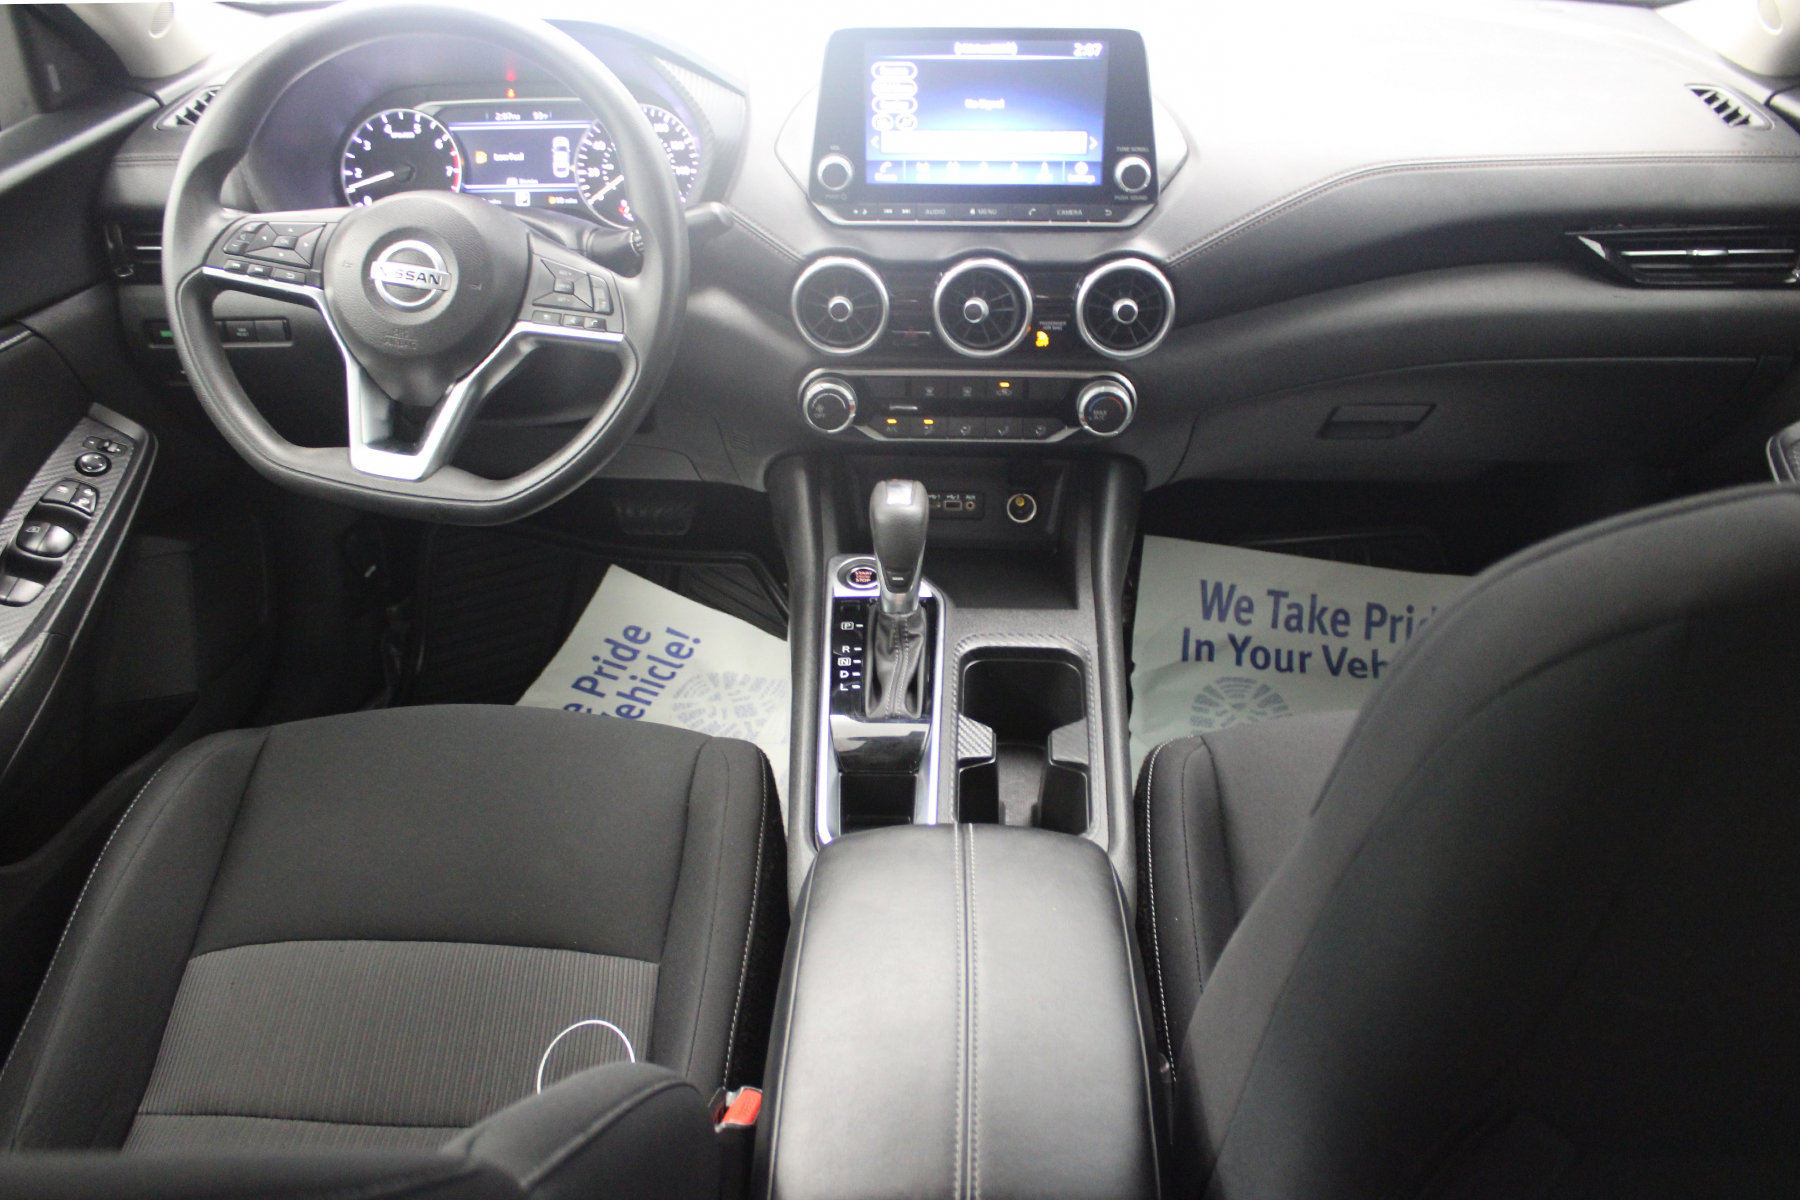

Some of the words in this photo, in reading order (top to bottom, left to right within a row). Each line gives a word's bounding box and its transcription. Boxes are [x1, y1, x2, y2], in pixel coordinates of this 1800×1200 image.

[1073, 42, 1102, 57] 2:07
[413, 123, 422, 134] 5
[363, 140, 371, 151] 3
[434, 138, 443, 149] 6
[355, 168, 362, 178] 2
[378, 265, 443, 286] NSSAN
[1200, 579, 1254, 626] We
[1267, 589, 1351, 638] Take
[1364, 602, 1437, 644] Pri
[841, 645, 850, 653] R
[1181, 628, 1215, 663] In
[1227, 632, 1312, 673] Your
[571, 625, 651, 698] Pride
[601, 627, 701, 720] ehicle!
[839, 670, 850, 679] D
[839, 683, 849, 691] L
